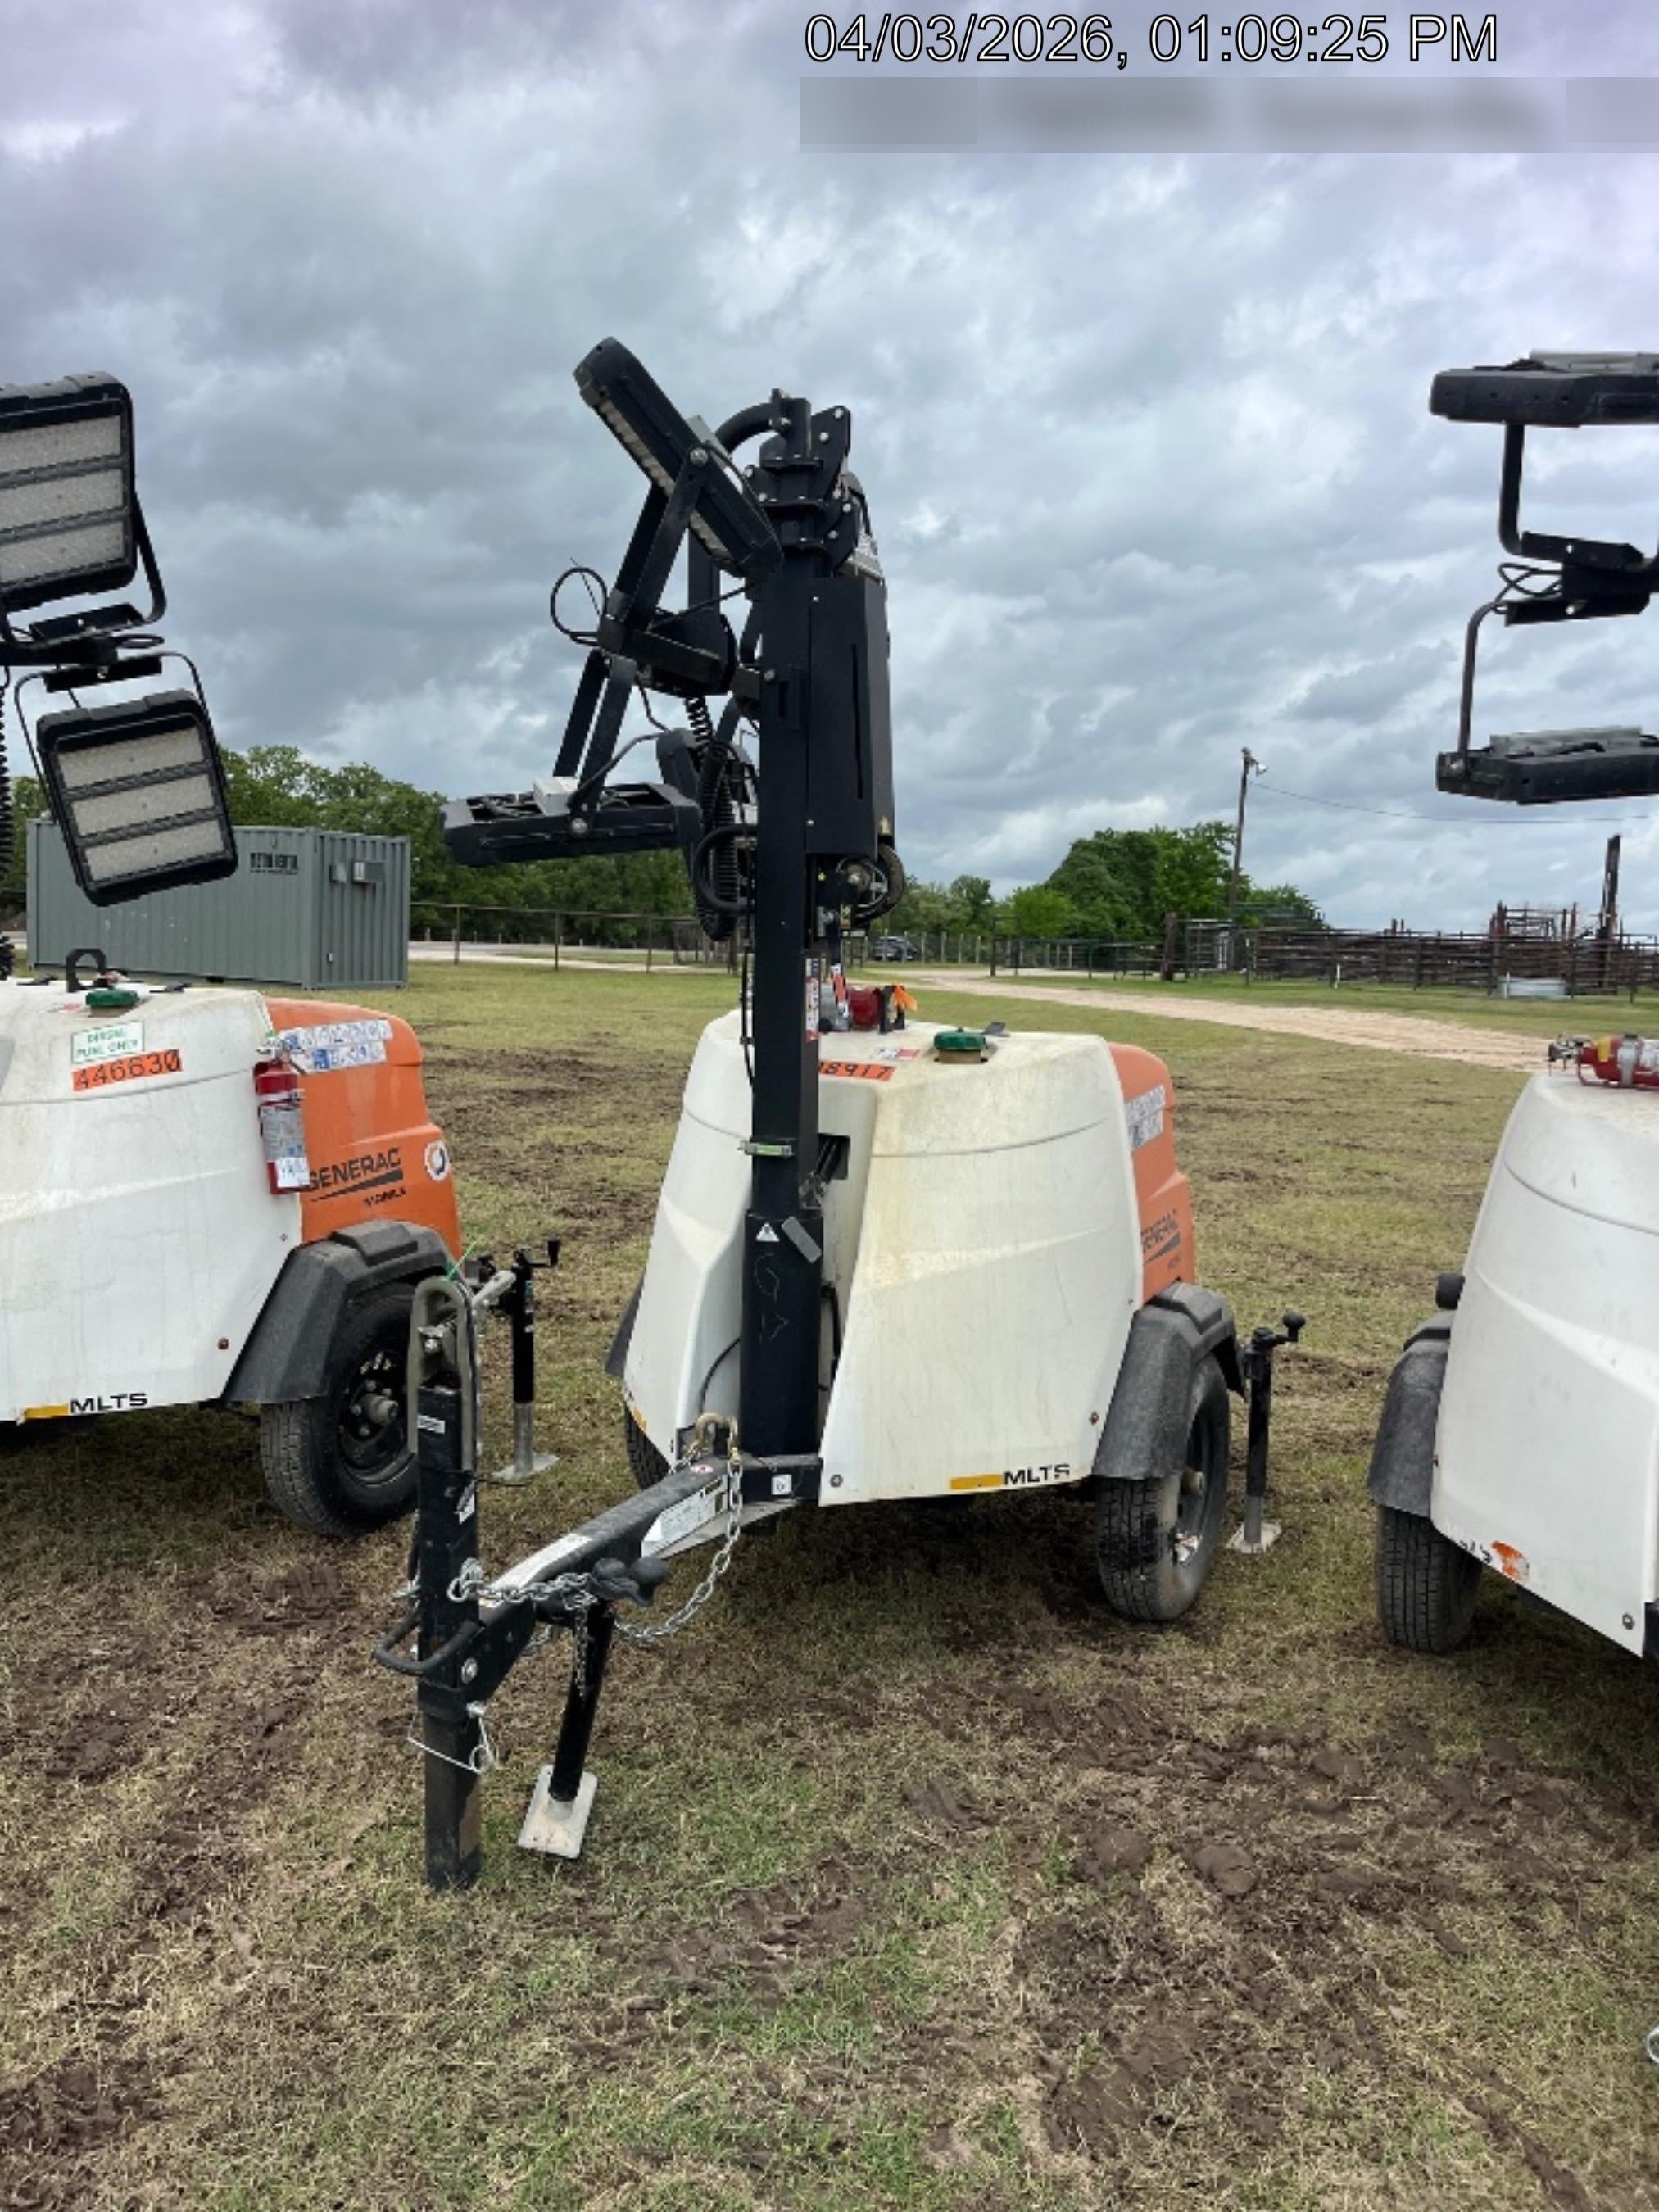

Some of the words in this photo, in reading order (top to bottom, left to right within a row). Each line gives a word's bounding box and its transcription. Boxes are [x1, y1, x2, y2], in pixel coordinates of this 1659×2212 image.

[77, 1049, 179, 1090] 446630
[70, 1392, 147, 1413] MLTS
[1003, 1463, 1070, 1485] MLTS
